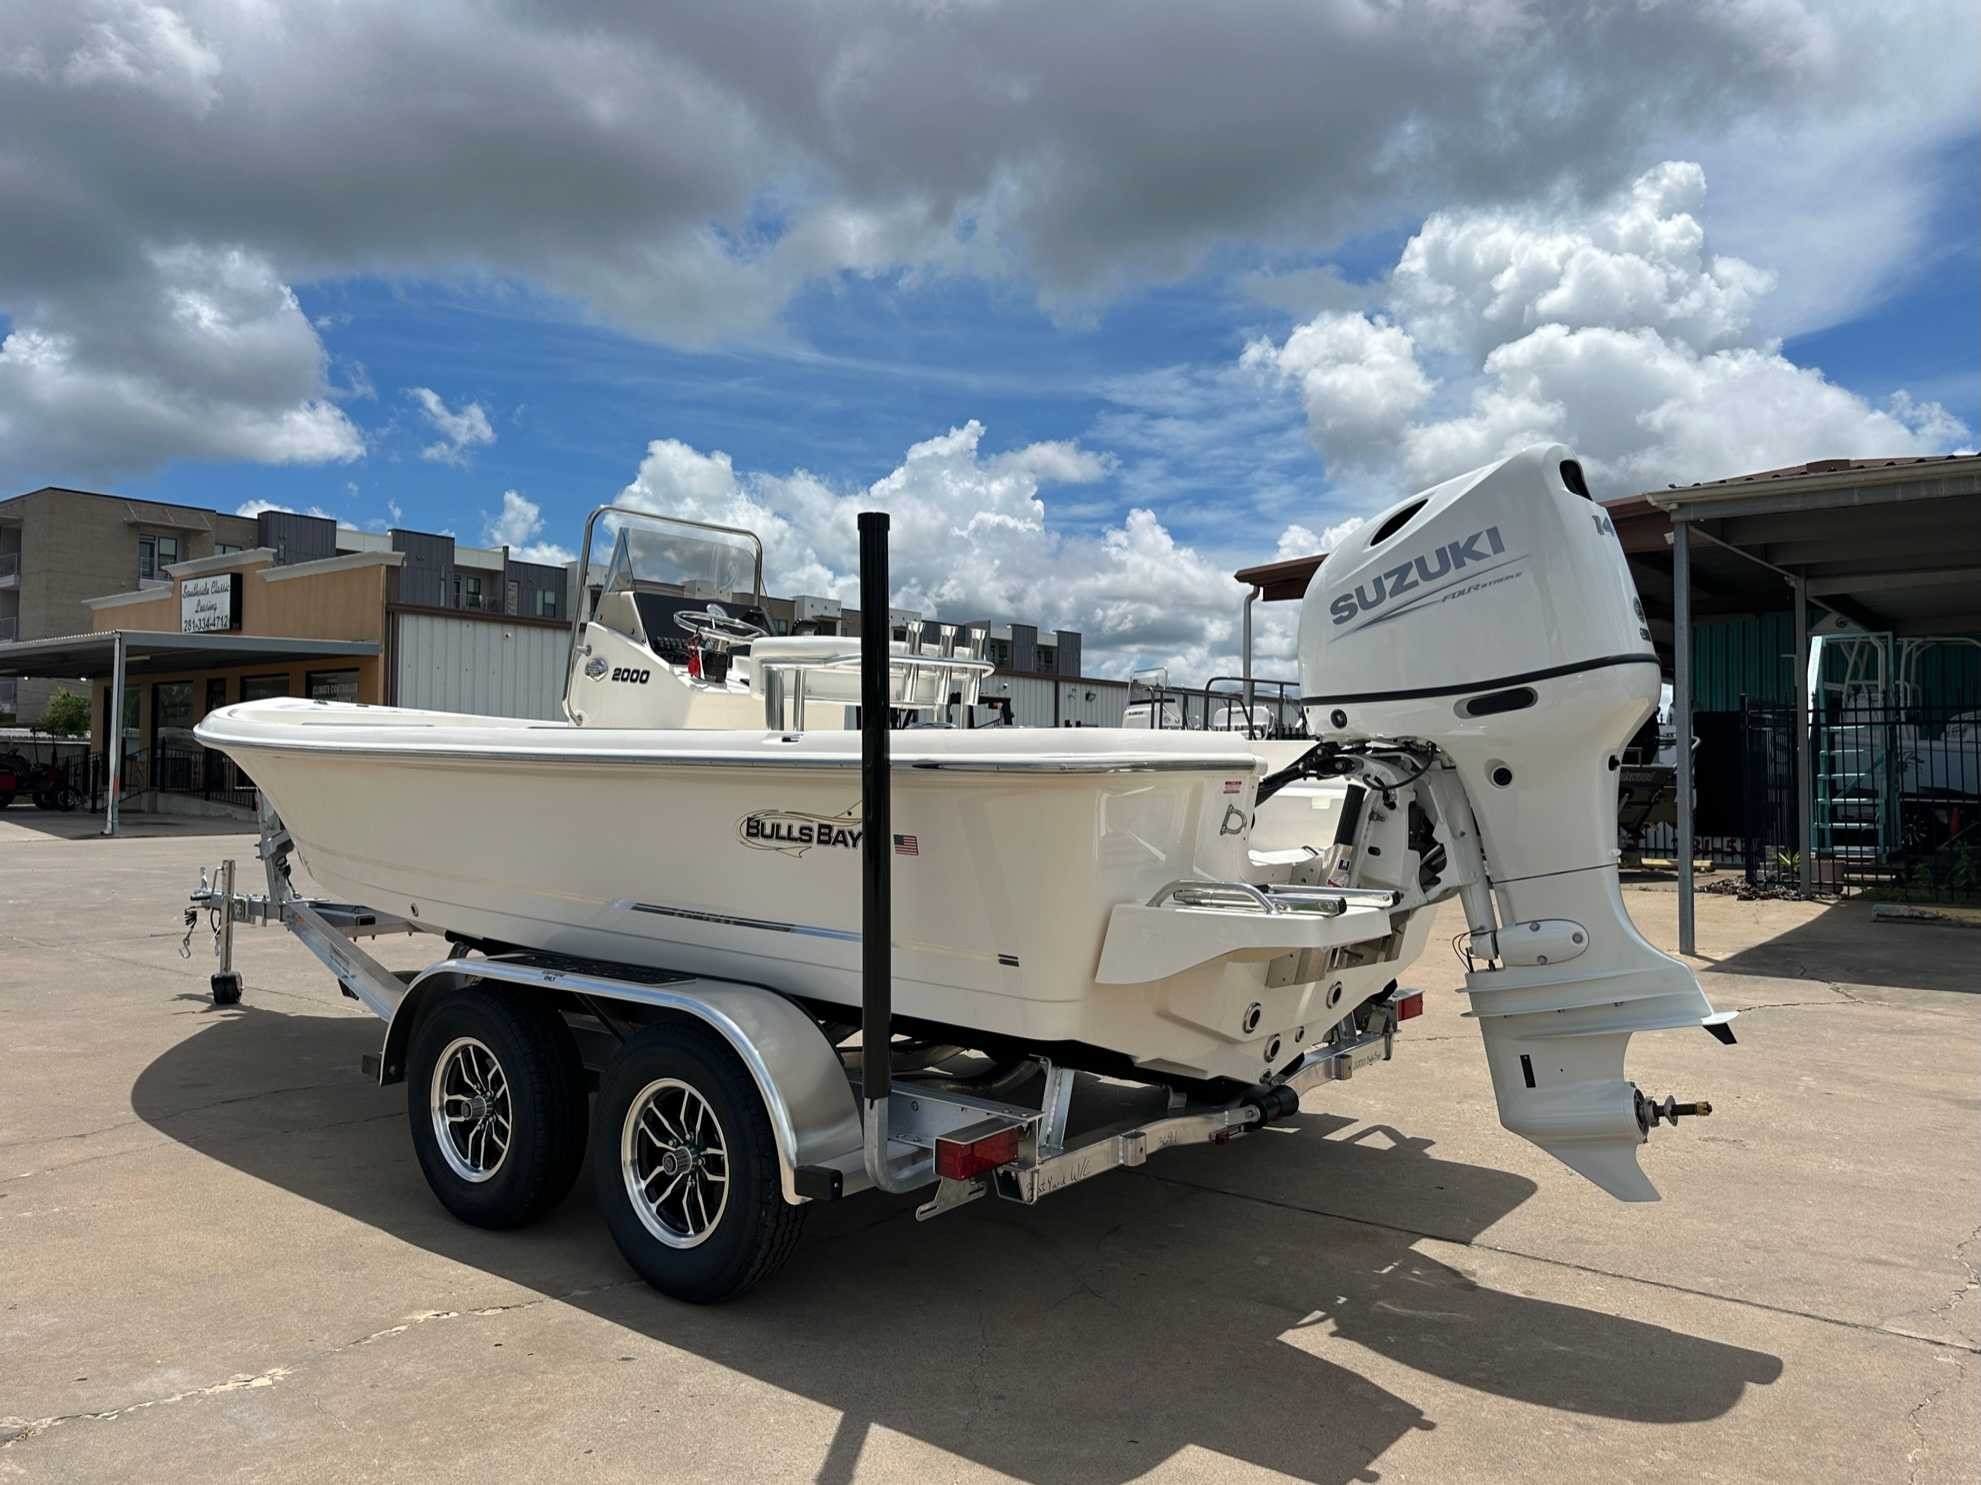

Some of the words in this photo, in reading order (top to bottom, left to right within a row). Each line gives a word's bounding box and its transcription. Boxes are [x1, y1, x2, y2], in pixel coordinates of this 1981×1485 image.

[1329, 526, 1505, 625] SUZUKI
[611, 667, 650, 684] 2000
[746, 817, 814, 843] BULLS
